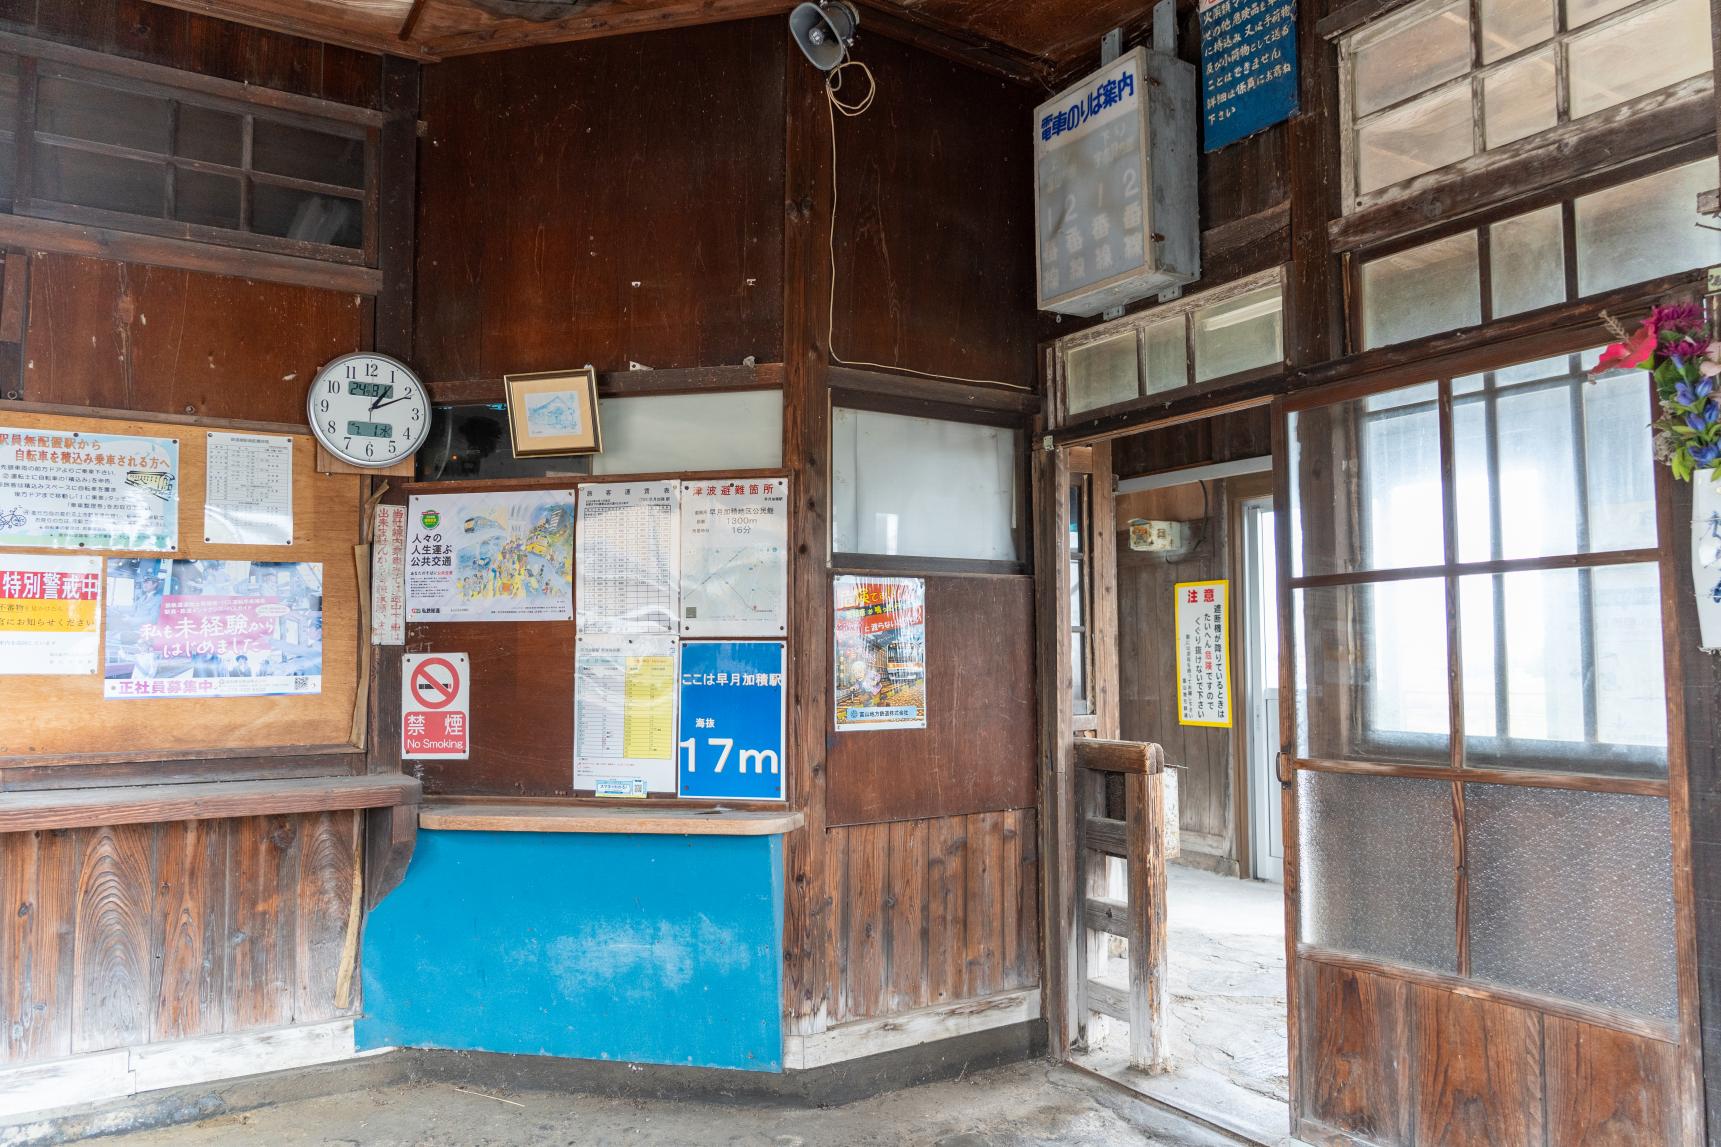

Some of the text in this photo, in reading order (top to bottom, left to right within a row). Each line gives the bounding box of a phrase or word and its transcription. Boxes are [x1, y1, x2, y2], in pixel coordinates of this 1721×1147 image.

[1041, 71, 1134, 142] 電車のりば案内
[345, 365, 356, 379] 11
[365, 363, 378, 377] 12
[391, 370, 395, 383] 1
[327, 380, 340, 394] 10
[404, 387, 412, 400] 2
[320, 399, 329, 412] 9
[411, 408, 419, 421] 3
[327, 420, 336, 434] 8
[403, 427, 410, 440] 4
[344, 437, 351, 450] 7
[365, 442, 374, 457] 6
[388, 440, 396, 453] 5
[15, 449, 170, 469] 自転車を積込み乗車される方へ
[692, 483, 774, 497] 津波避難箇所
[727, 516, 758, 525] 1300m
[732, 525, 752, 534] 16分
[411, 532, 442, 543] 人々の
[411, 544, 453, 556] 人生運ぶ
[410, 556, 452, 567] 公共交通
[2, 571, 98, 600] 特別警戒中
[1187, 588, 1215, 604] 注意
[141, 614, 274, 641] 私も未経験から
[163, 638, 260, 658] はじめました
[1194, 617, 1205, 718] くぐり抜けないで下さい
[1203, 613, 1215, 710] たいへん危険ですので
[1213, 604, 1225, 718] 遮断機が降りているときは
[119, 679, 213, 694] 正社員募集中
[682, 672, 782, 687] ここは早月加積駅
[407, 714, 463, 736] 禁煙
[695, 717, 716, 729] 海抜
[407, 739, 464, 749] No Smoking
[680, 737, 779, 775] 17m
